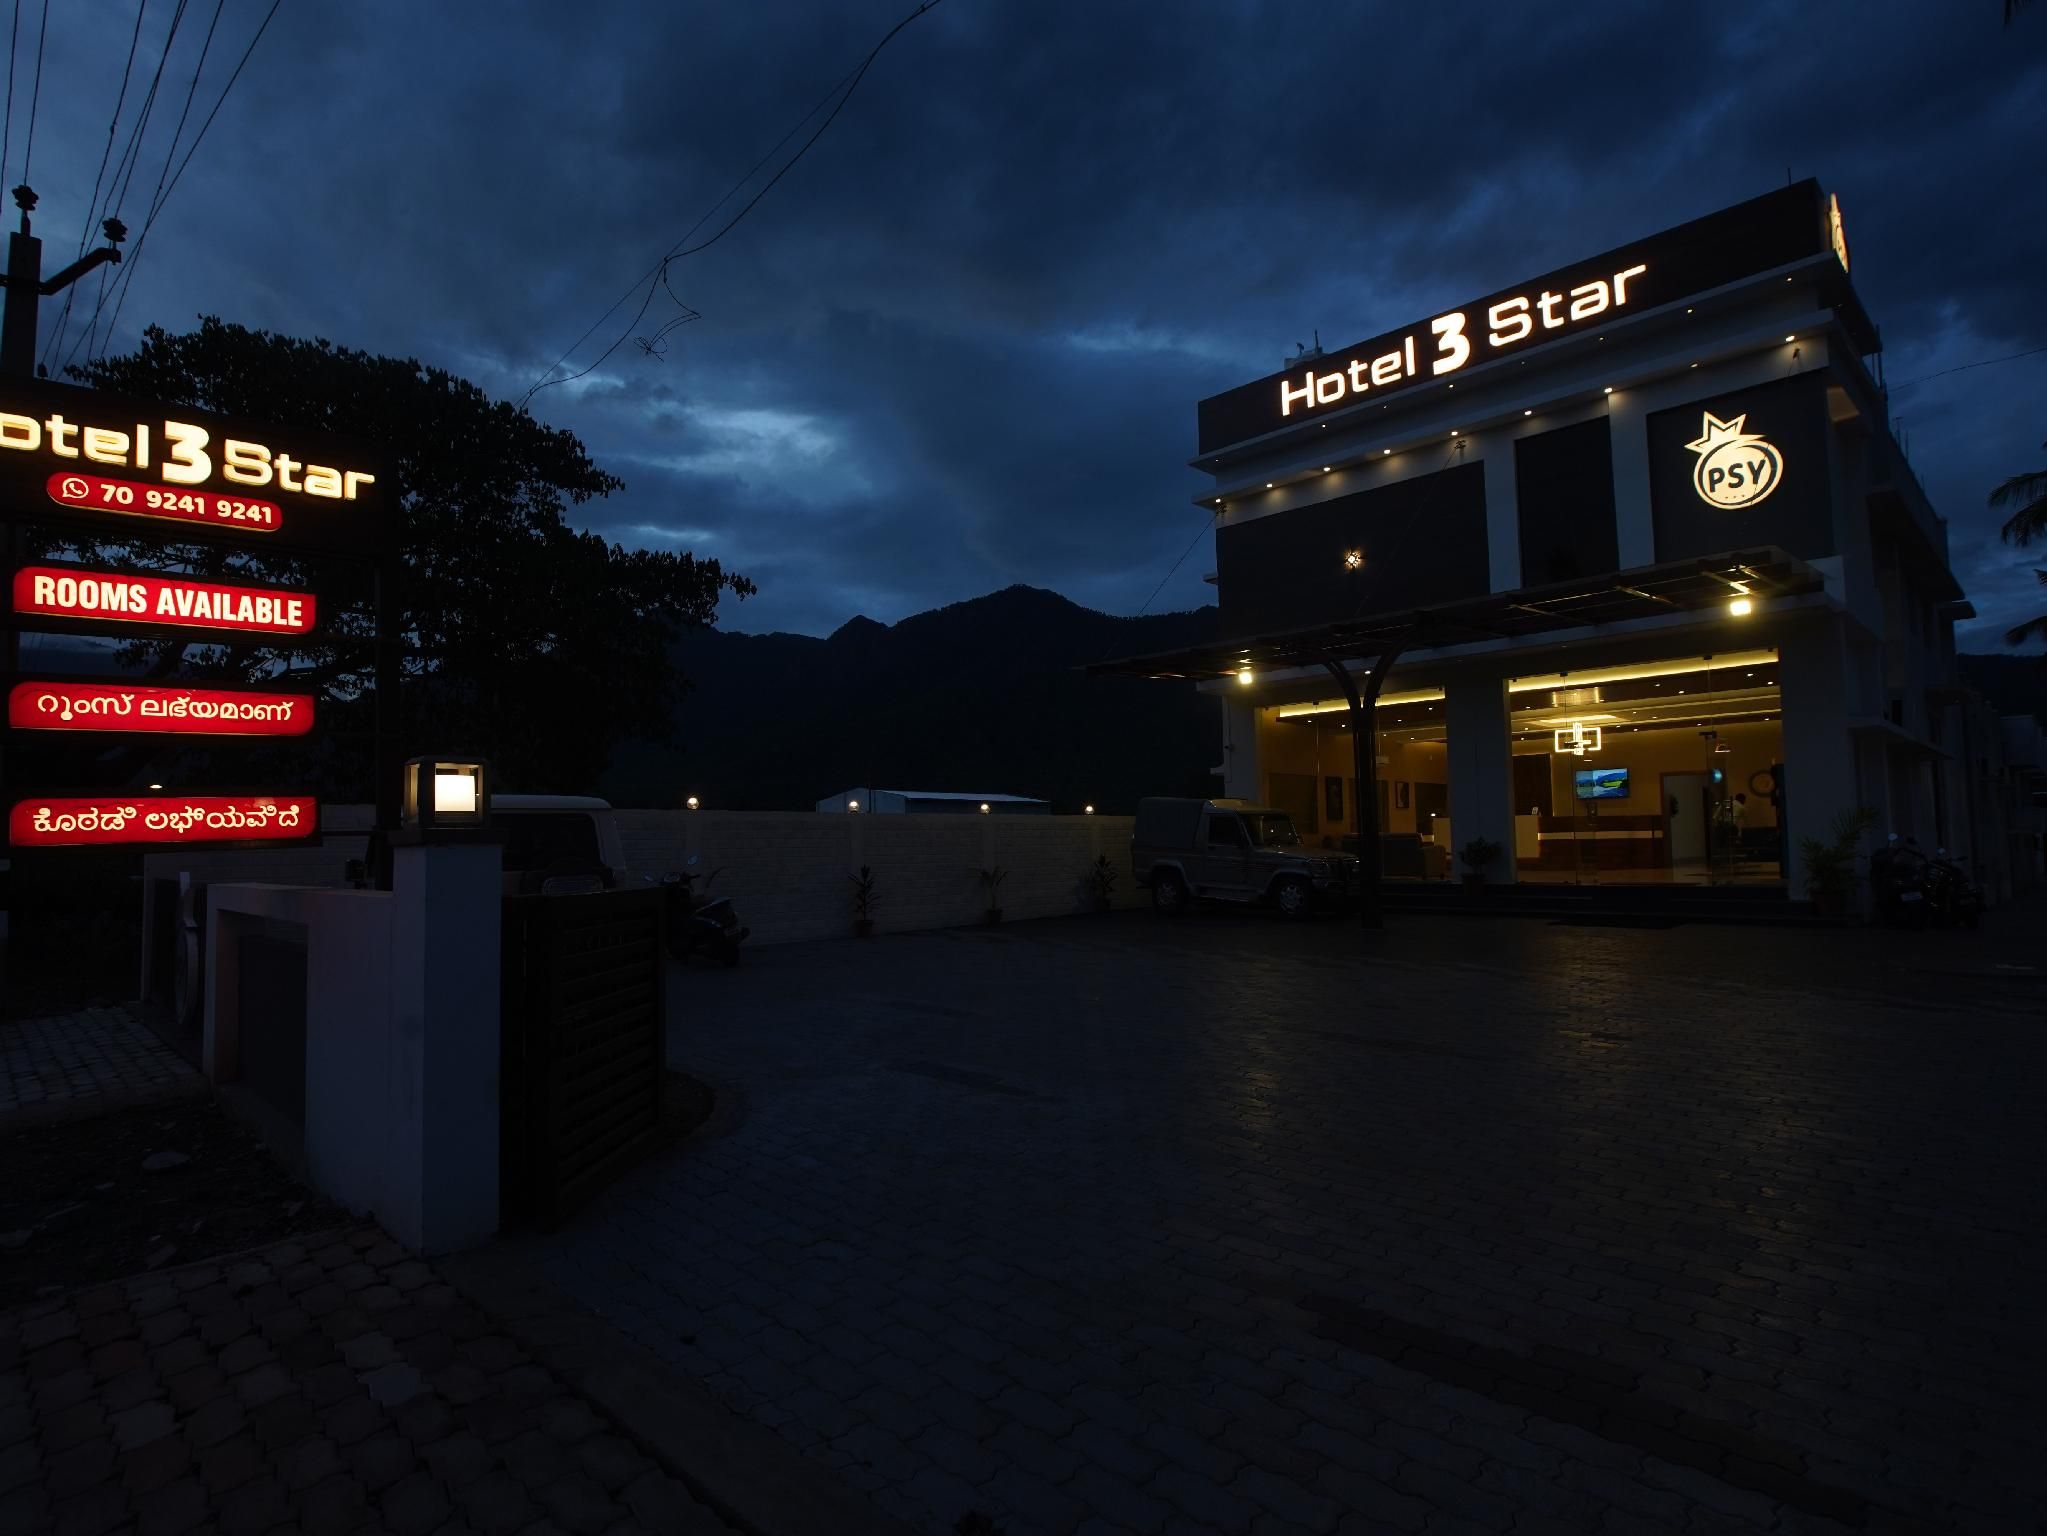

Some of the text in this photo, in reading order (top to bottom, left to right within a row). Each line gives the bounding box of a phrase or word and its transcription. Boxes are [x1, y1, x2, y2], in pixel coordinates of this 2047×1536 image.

[1281, 265, 1647, 417] Hotel 3 Star
[0, 412, 376, 501] otel 3 Star
[1708, 459, 1766, 493] PSY
[100, 484, 272, 524] 70 9241 9241
[34, 576, 303, 627] ROOMS AVAILABLE
